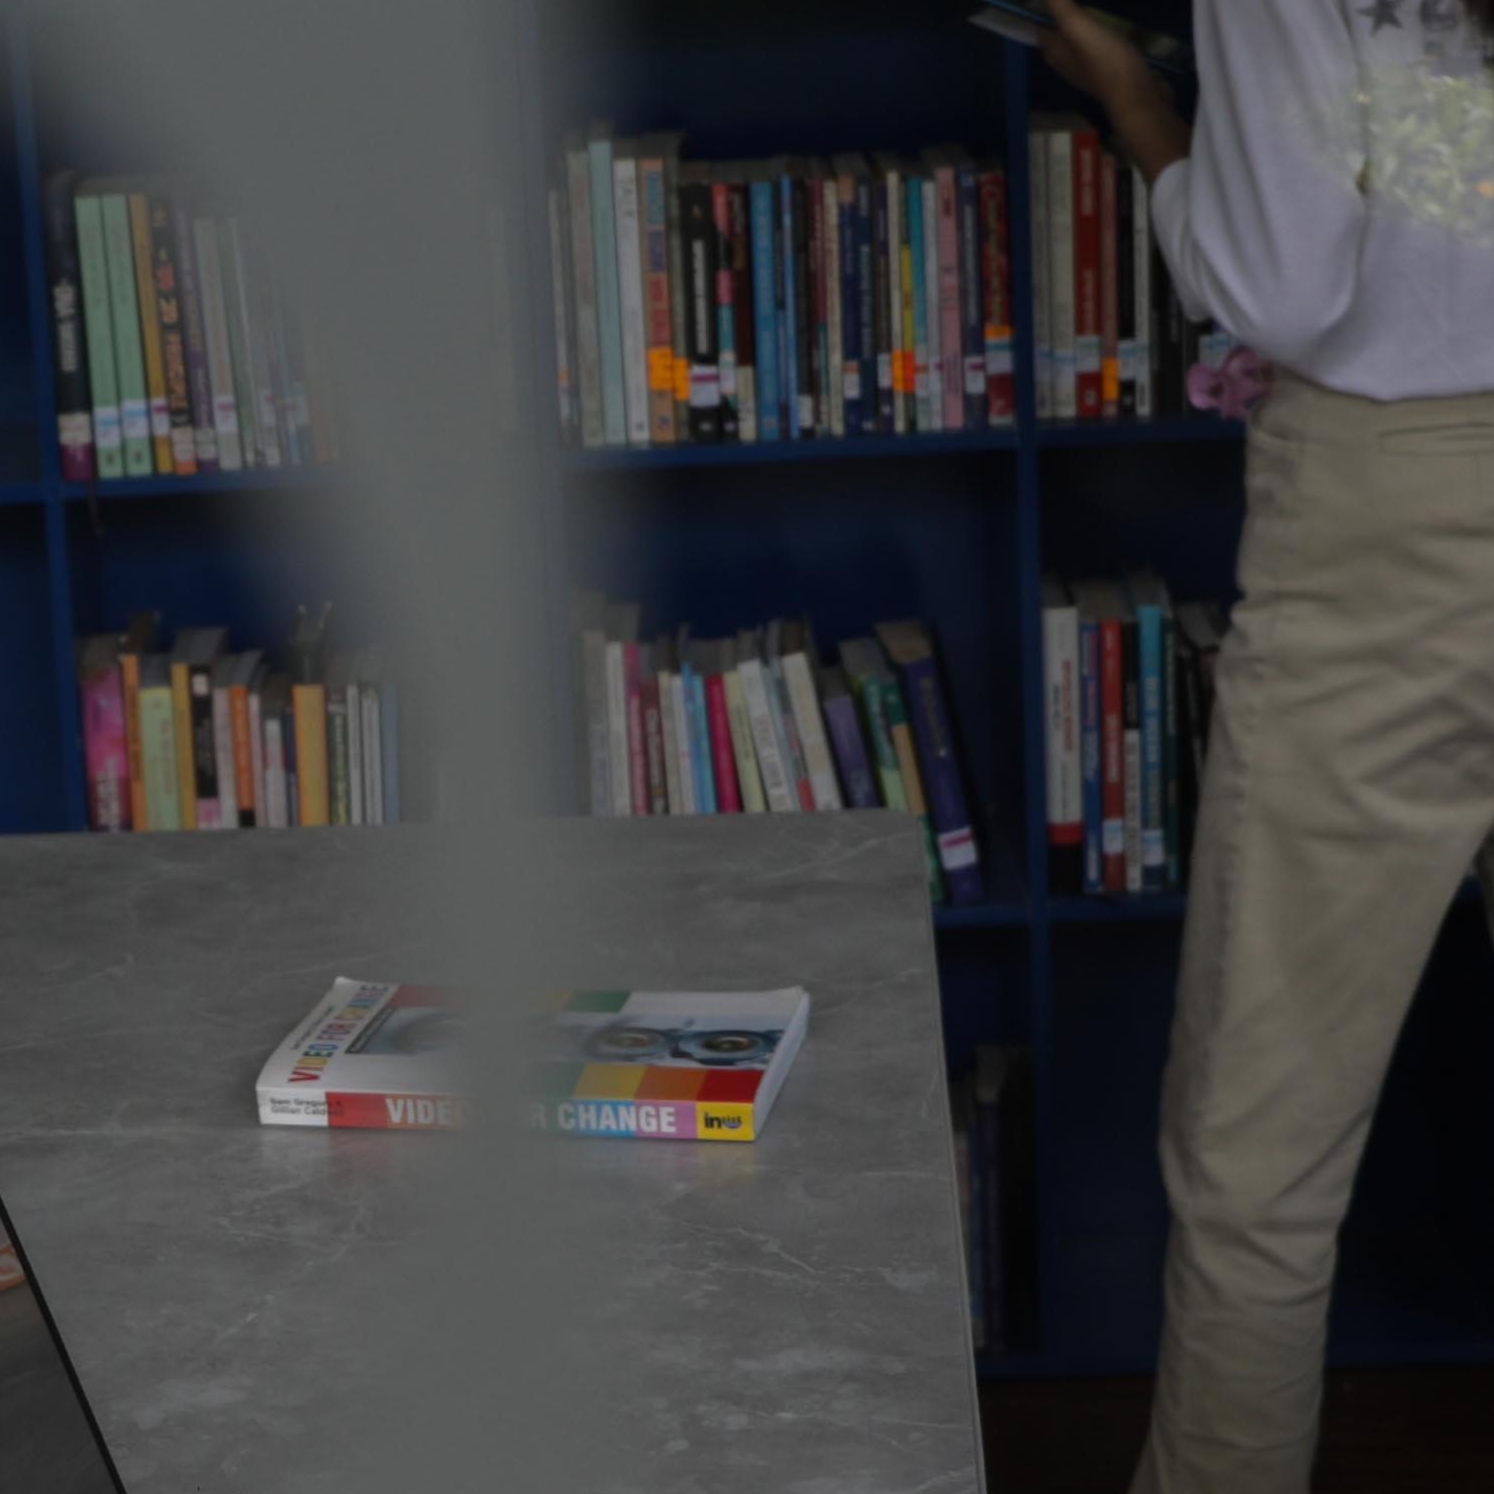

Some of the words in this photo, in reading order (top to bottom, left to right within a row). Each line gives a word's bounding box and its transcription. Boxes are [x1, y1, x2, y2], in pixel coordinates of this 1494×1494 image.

[287, 1043, 339, 1083] VIDEO
[315, 1022, 358, 1041] FOR
[557, 1102, 677, 1133] CHANGE
